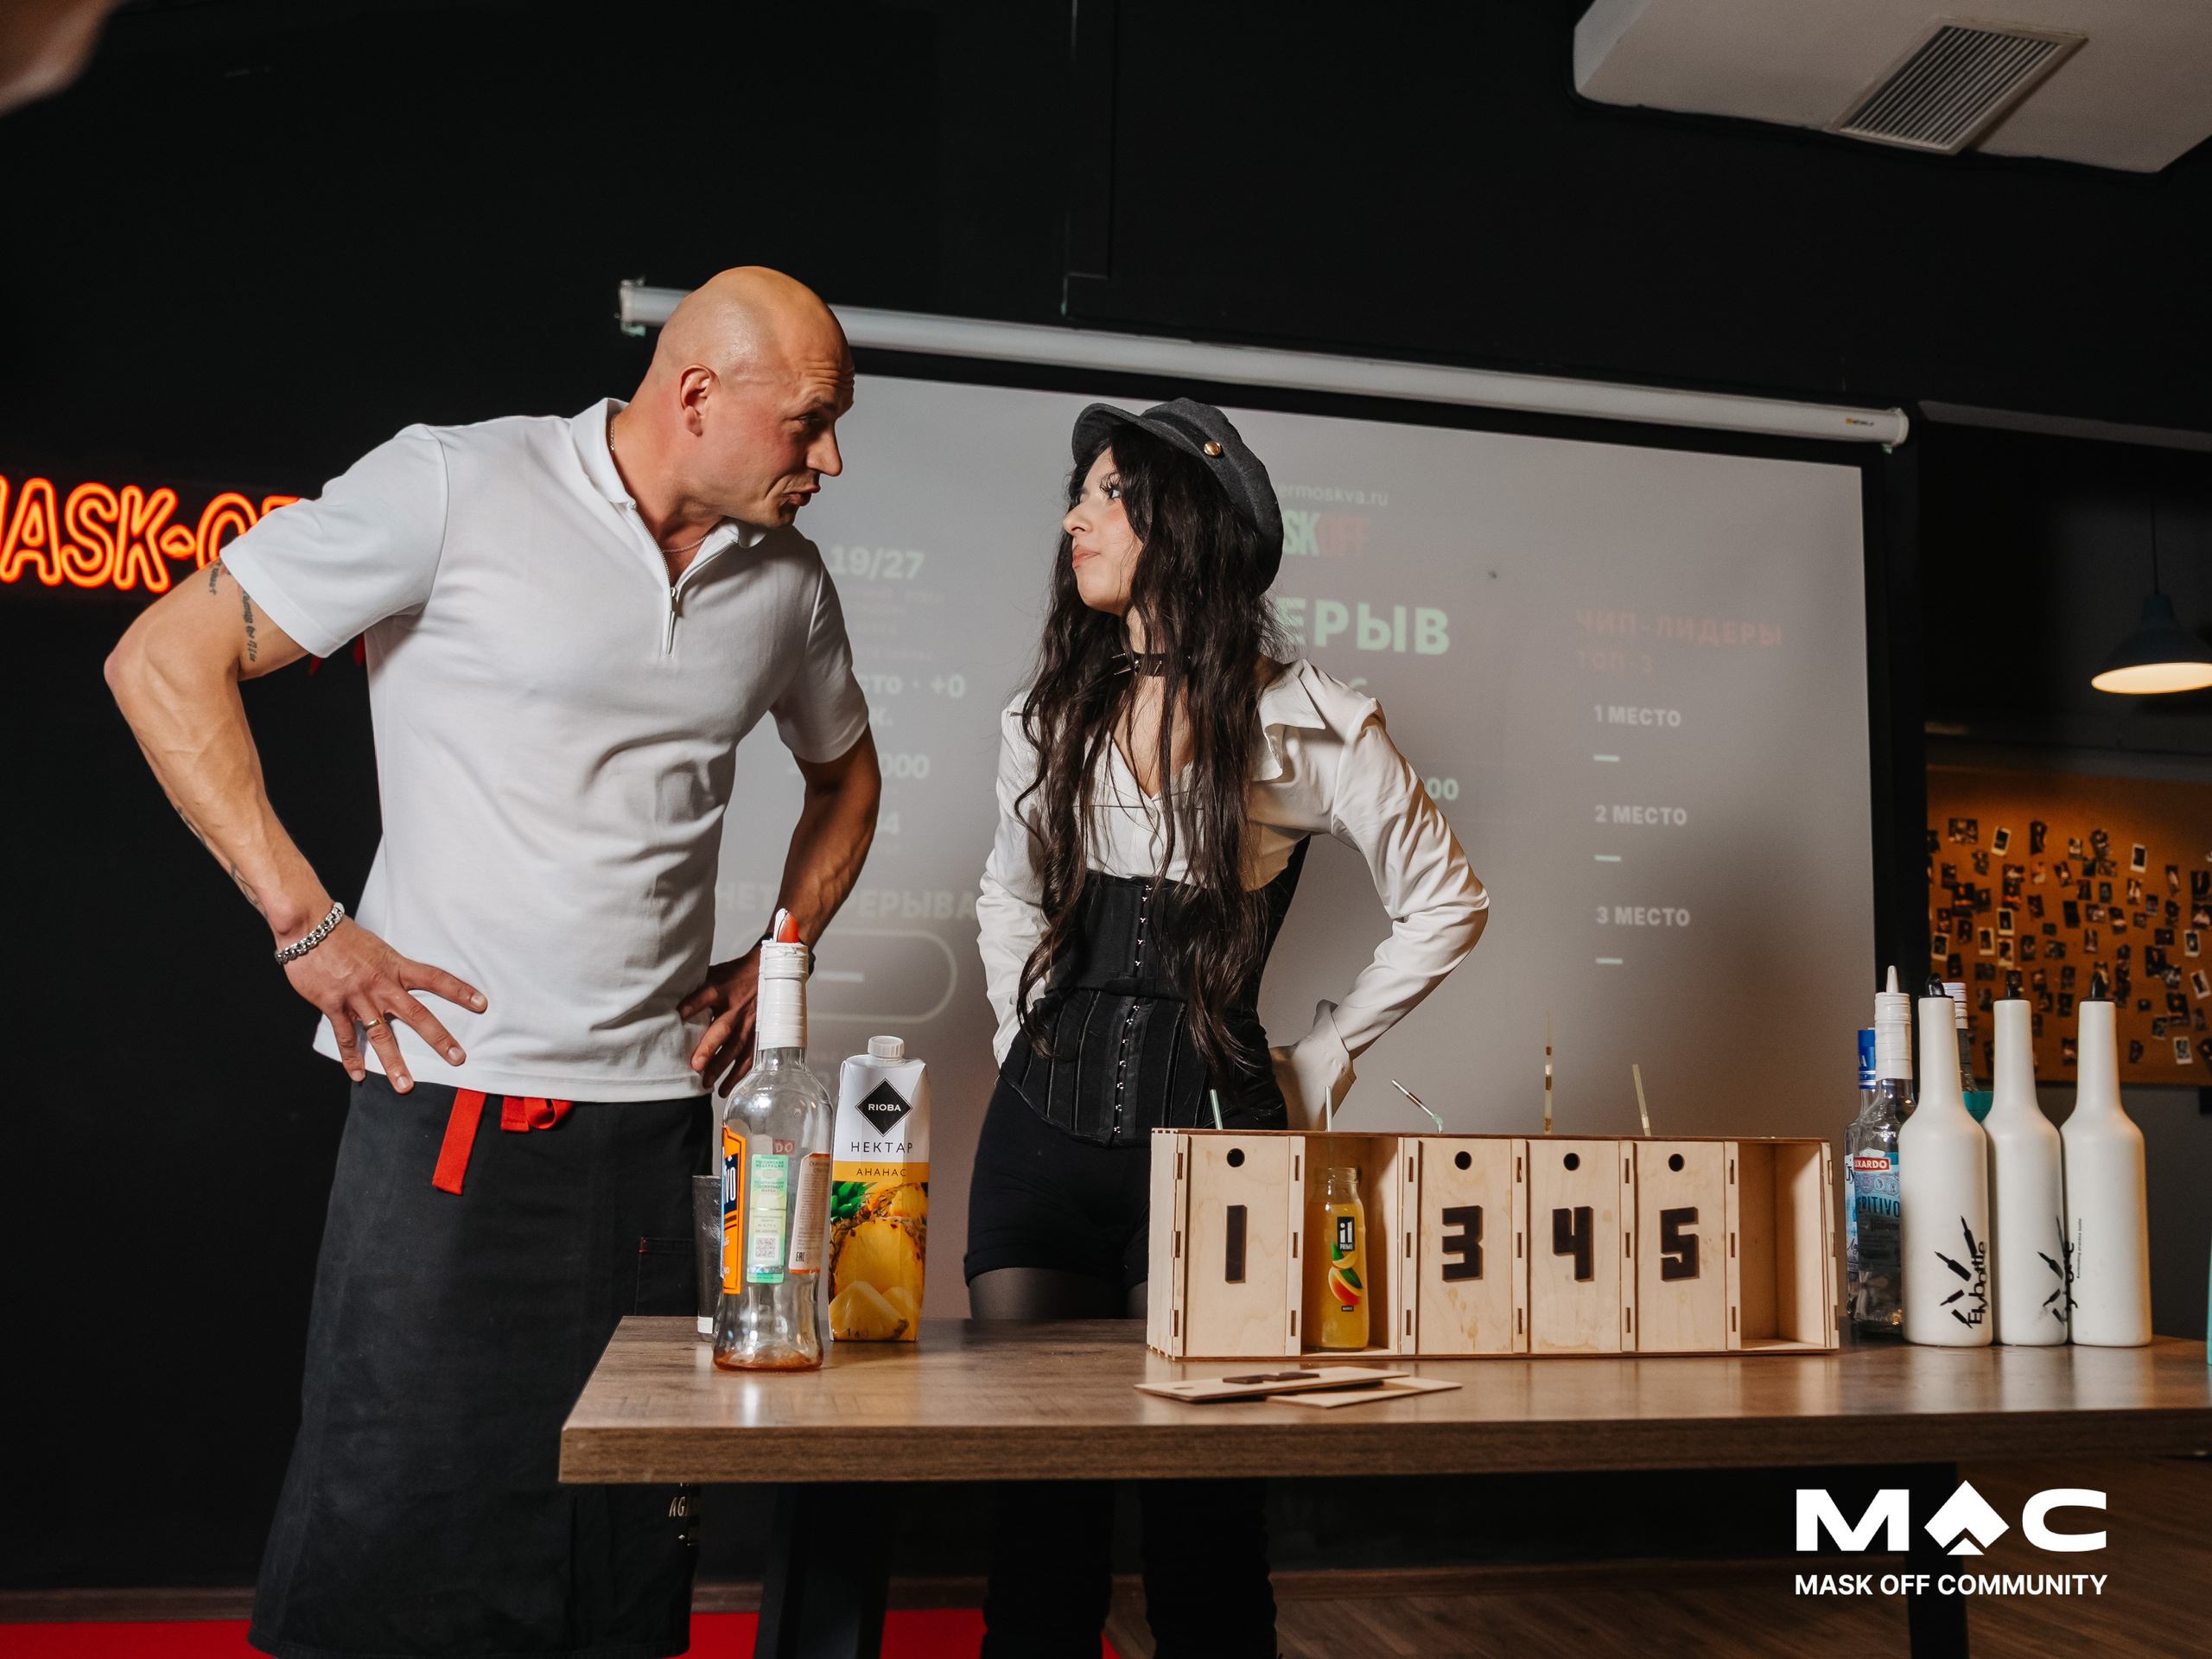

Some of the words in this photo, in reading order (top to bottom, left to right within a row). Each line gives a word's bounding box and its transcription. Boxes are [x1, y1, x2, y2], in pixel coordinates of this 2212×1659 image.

[1274, 484, 1389, 507] ermoskva.ru
[0, 475, 178, 594] ASK
[830, 545, 925, 582] 19/27
[1594, 704, 1604, 722] 1
[1608, 705, 1682, 728] МЕСТО
[1594, 804, 1608, 823] 2
[1613, 805, 1688, 827] МЕСТО
[1596, 906, 1609, 925] 3
[1615, 906, 1691, 927] МЕСТО
[868, 1103, 902, 1112] RIOBA
[851, 1141, 913, 1154] НЕКТАР
[856, 1167, 907, 1177] АНАНАС
[1339, 1221, 1353, 1243] il
[1441, 1205, 1483, 1282] 3
[1553, 1205, 1593, 1282] 4
[1660, 1206, 1700, 1281] 5
[846, 1327, 851, 1337] 1
